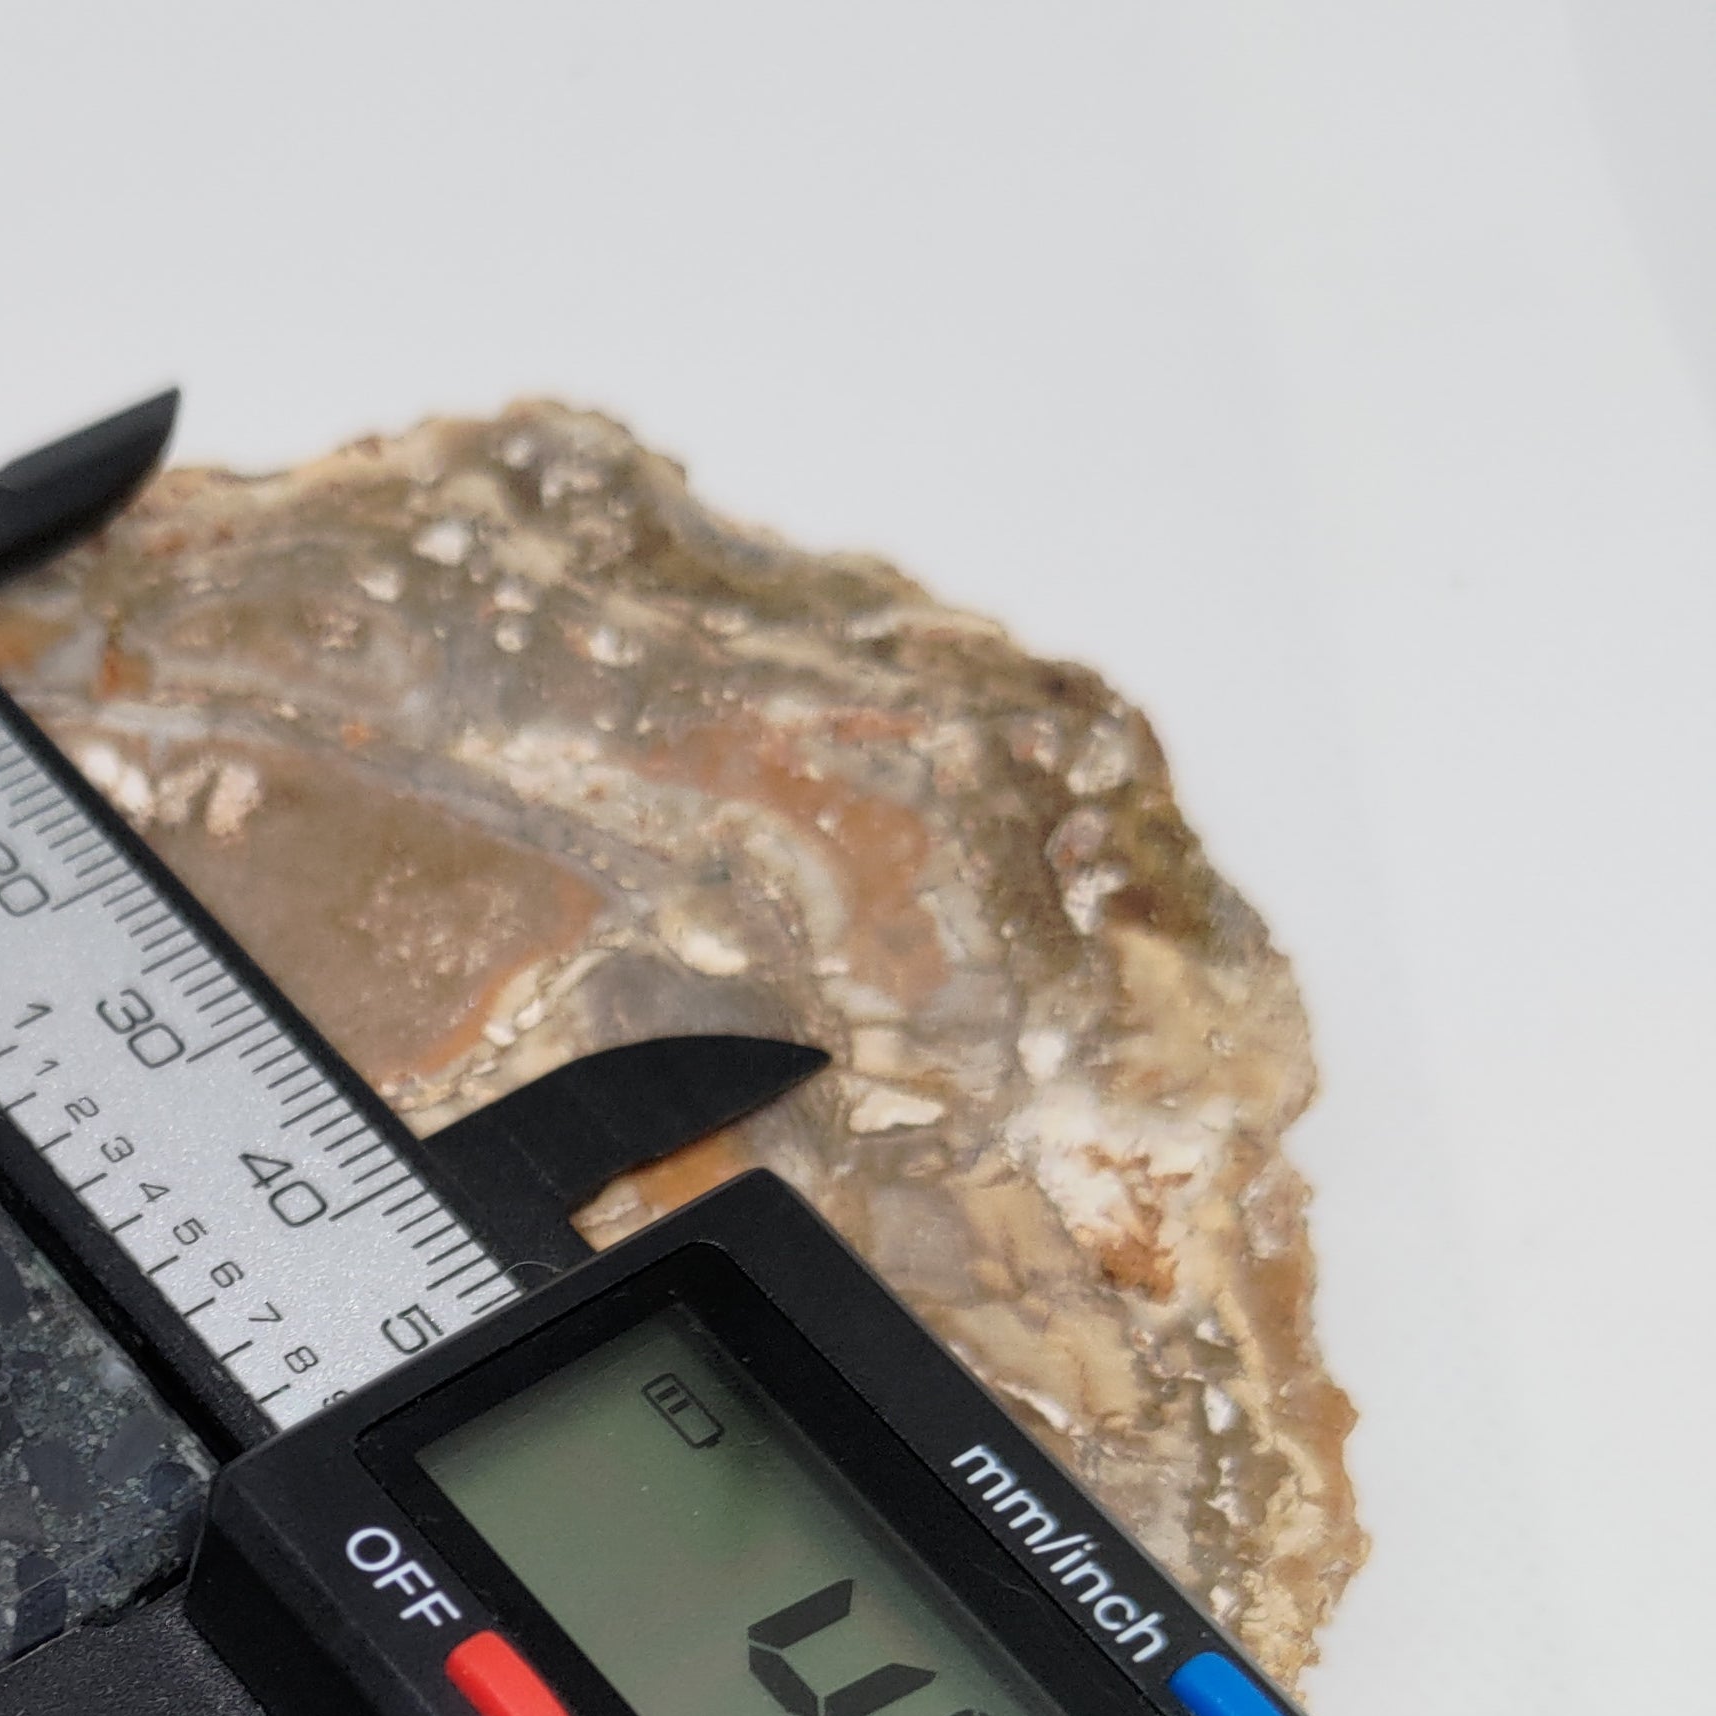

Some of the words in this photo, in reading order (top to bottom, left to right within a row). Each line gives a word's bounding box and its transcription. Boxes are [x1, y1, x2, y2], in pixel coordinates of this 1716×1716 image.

[14, 1002, 52, 1030] 1
[36, 1059, 59, 1076] 1
[64, 1096, 100, 1124] 2
[100, 1136, 135, 1163] 3
[138, 1182, 171, 1203] 4
[172, 1217, 209, 1246] 5
[209, 1261, 245, 1289] 6
[248, 1301, 283, 1323] 7
[283, 1345, 319, 1374] 8
[95, 988, 185, 1069] 30
[239, 1153, 327, 1228] 40
[344, 1525, 462, 1631] OFF
[950, 1441, 1172, 1663] mm/inch
